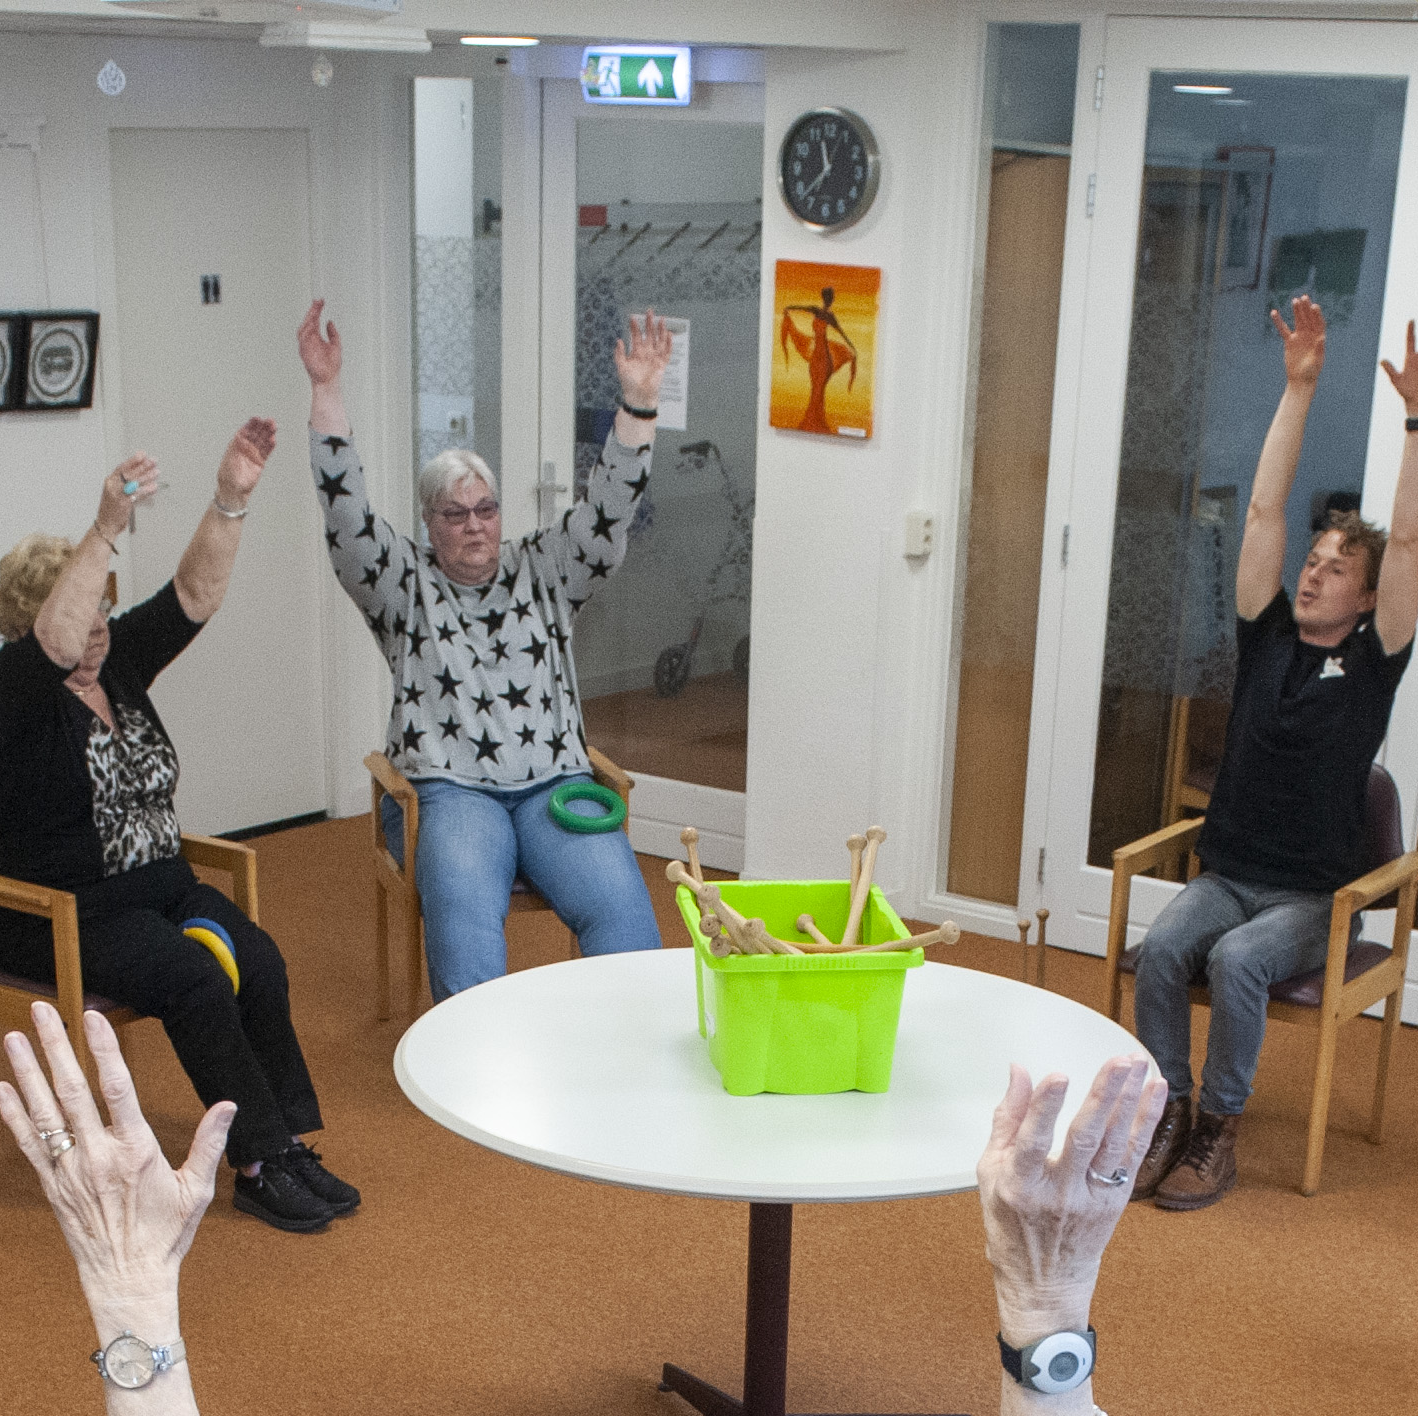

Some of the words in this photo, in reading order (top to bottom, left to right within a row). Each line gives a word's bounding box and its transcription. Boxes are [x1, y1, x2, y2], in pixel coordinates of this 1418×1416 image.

[809, 127, 822, 142] 11
[824, 123, 837, 138] 12
[842, 129, 849, 143] 1
[796, 141, 810, 158] 10
[851, 145, 861, 160] 2
[793, 161, 802, 177] 9
[855, 165, 864, 181] 3
[849, 186, 858, 199] 4
[806, 196, 816, 210] 7
[821, 203, 831, 217] 6
